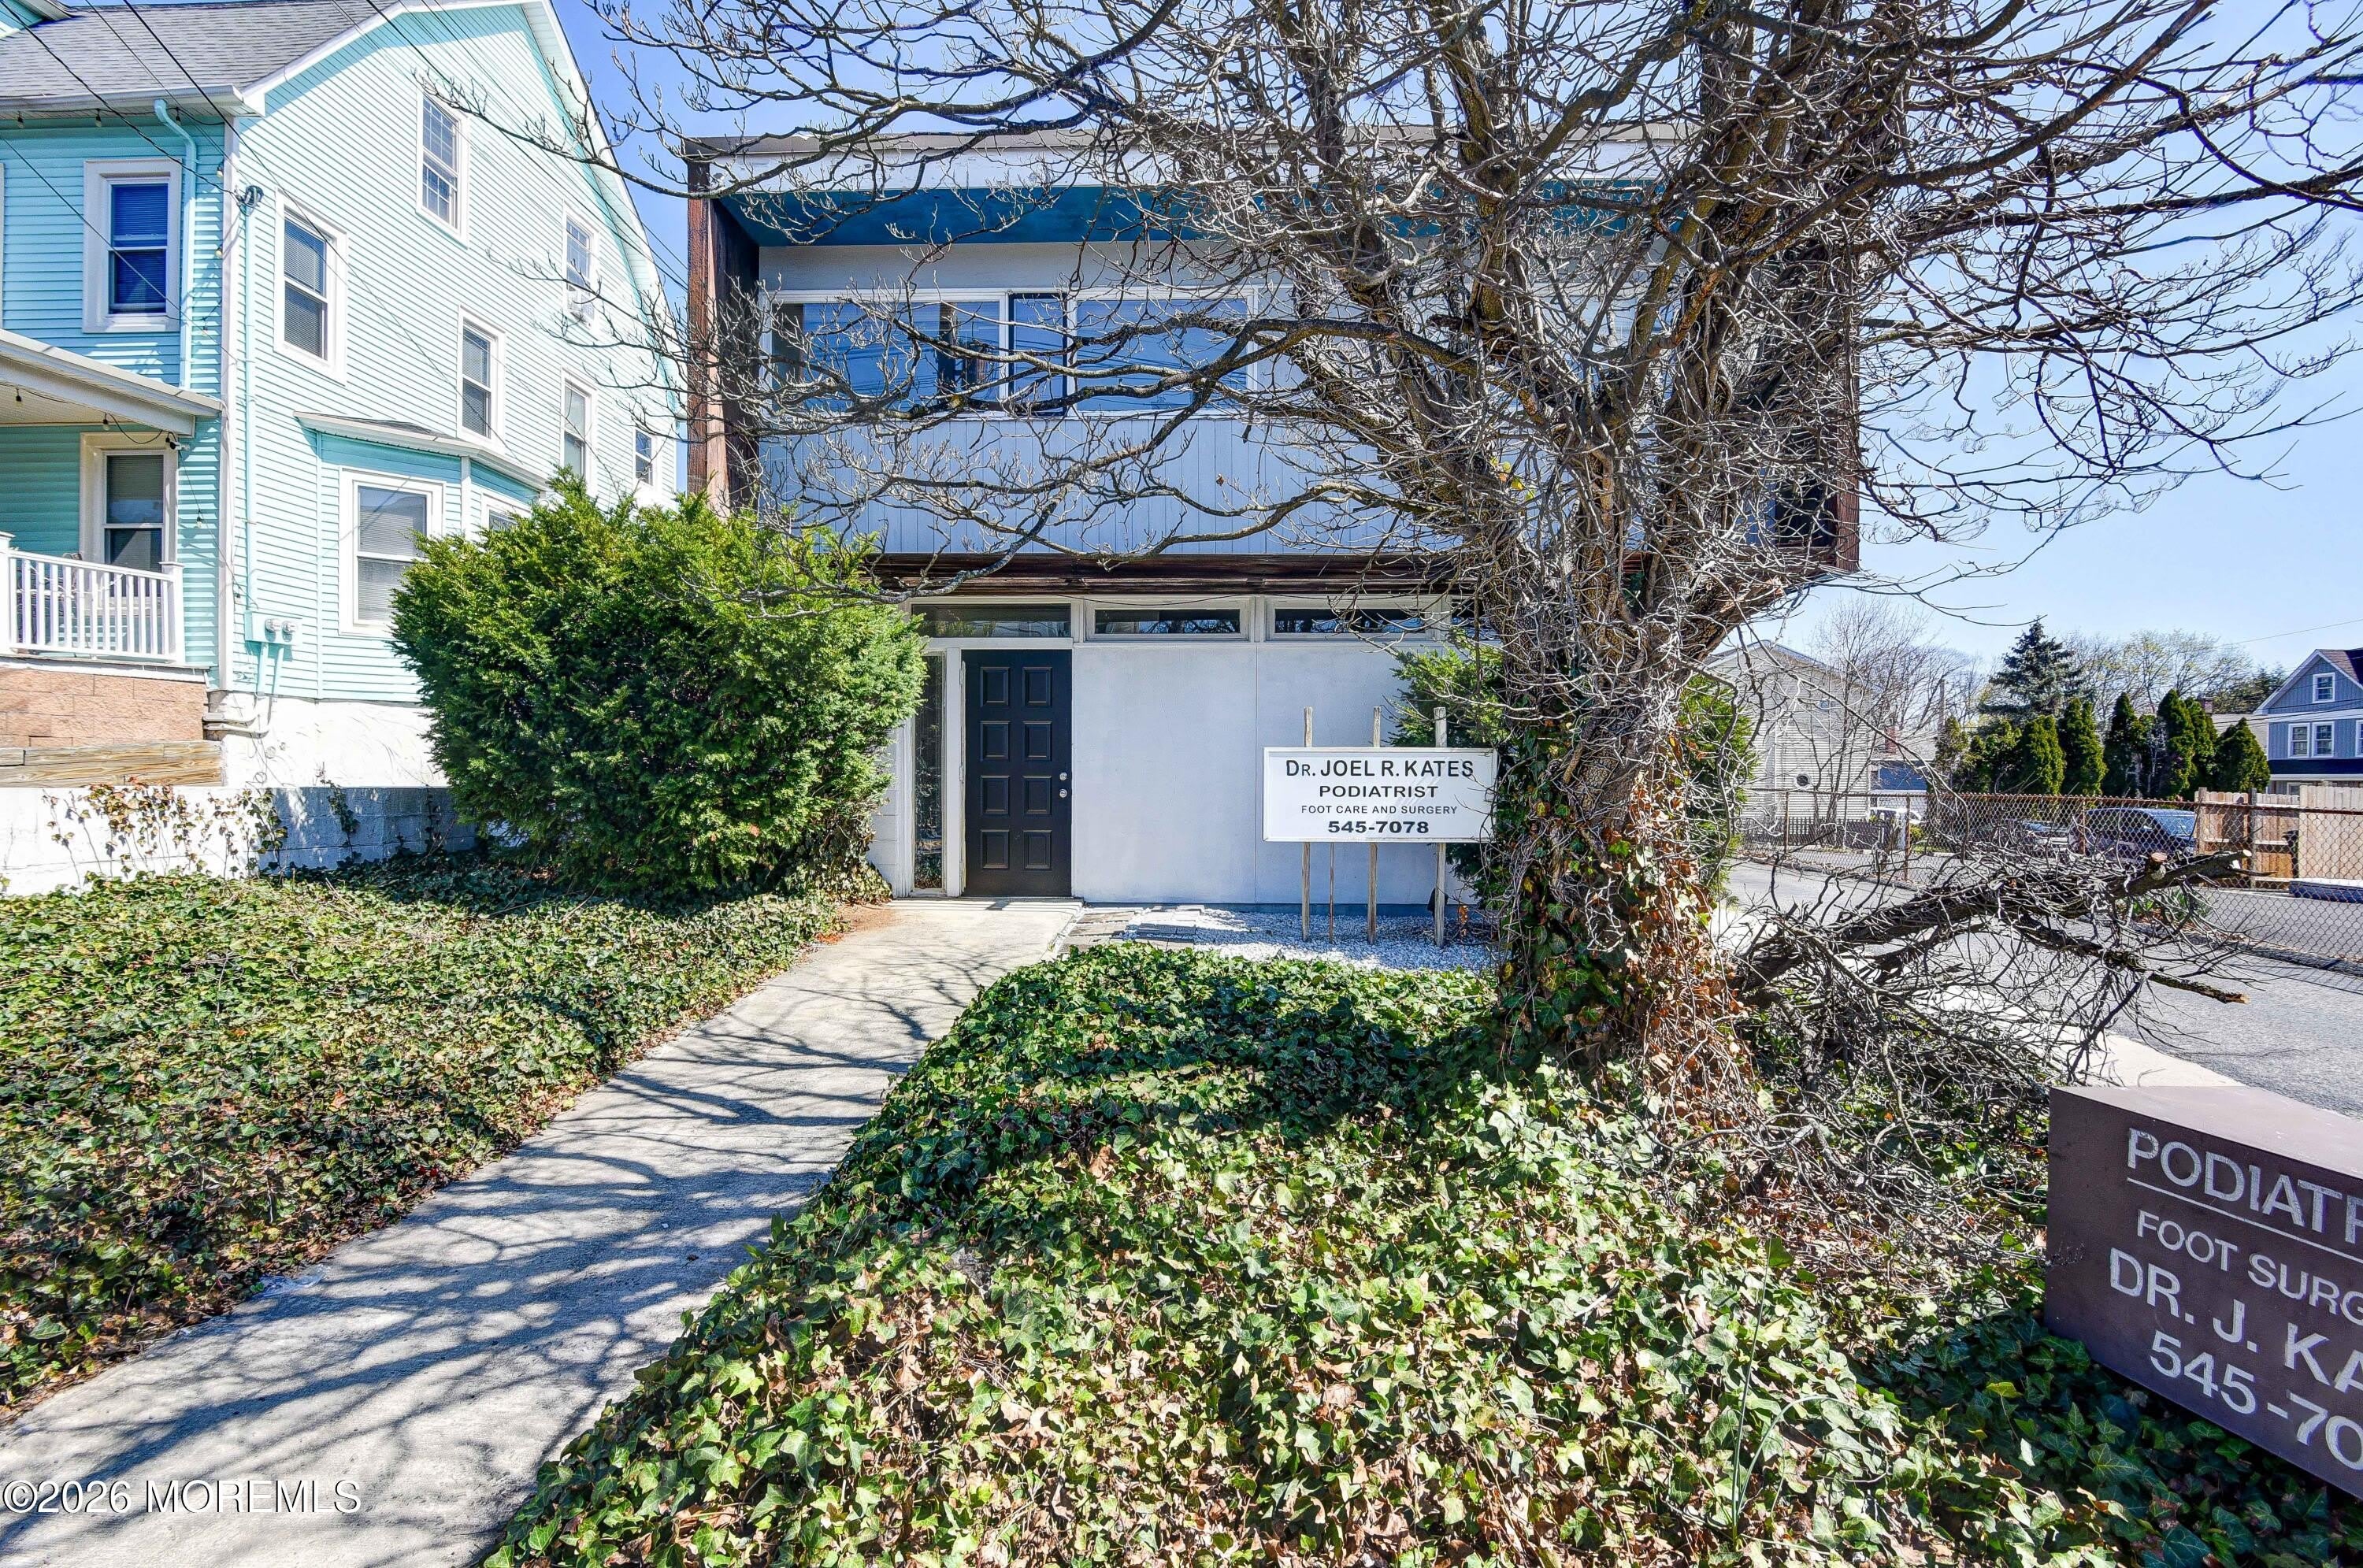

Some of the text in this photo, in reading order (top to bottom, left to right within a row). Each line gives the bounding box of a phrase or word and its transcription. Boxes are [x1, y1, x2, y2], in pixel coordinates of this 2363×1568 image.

[1320, 760, 1375, 777] JOEL
[1382, 760, 1400, 777] R.
[1405, 760, 1474, 777] KATES
[1319, 786, 1438, 798] PODIATRIST
[1301, 806, 1457, 814] FOOT CARE AND SURGERY
[1328, 821, 1430, 834] 545-7078
[2137, 1210, 2363, 1326] FOOT SURG
[2110, 1247, 2363, 1399] DR. J. KA
[2150, 1330, 2363, 1471] 545-70
